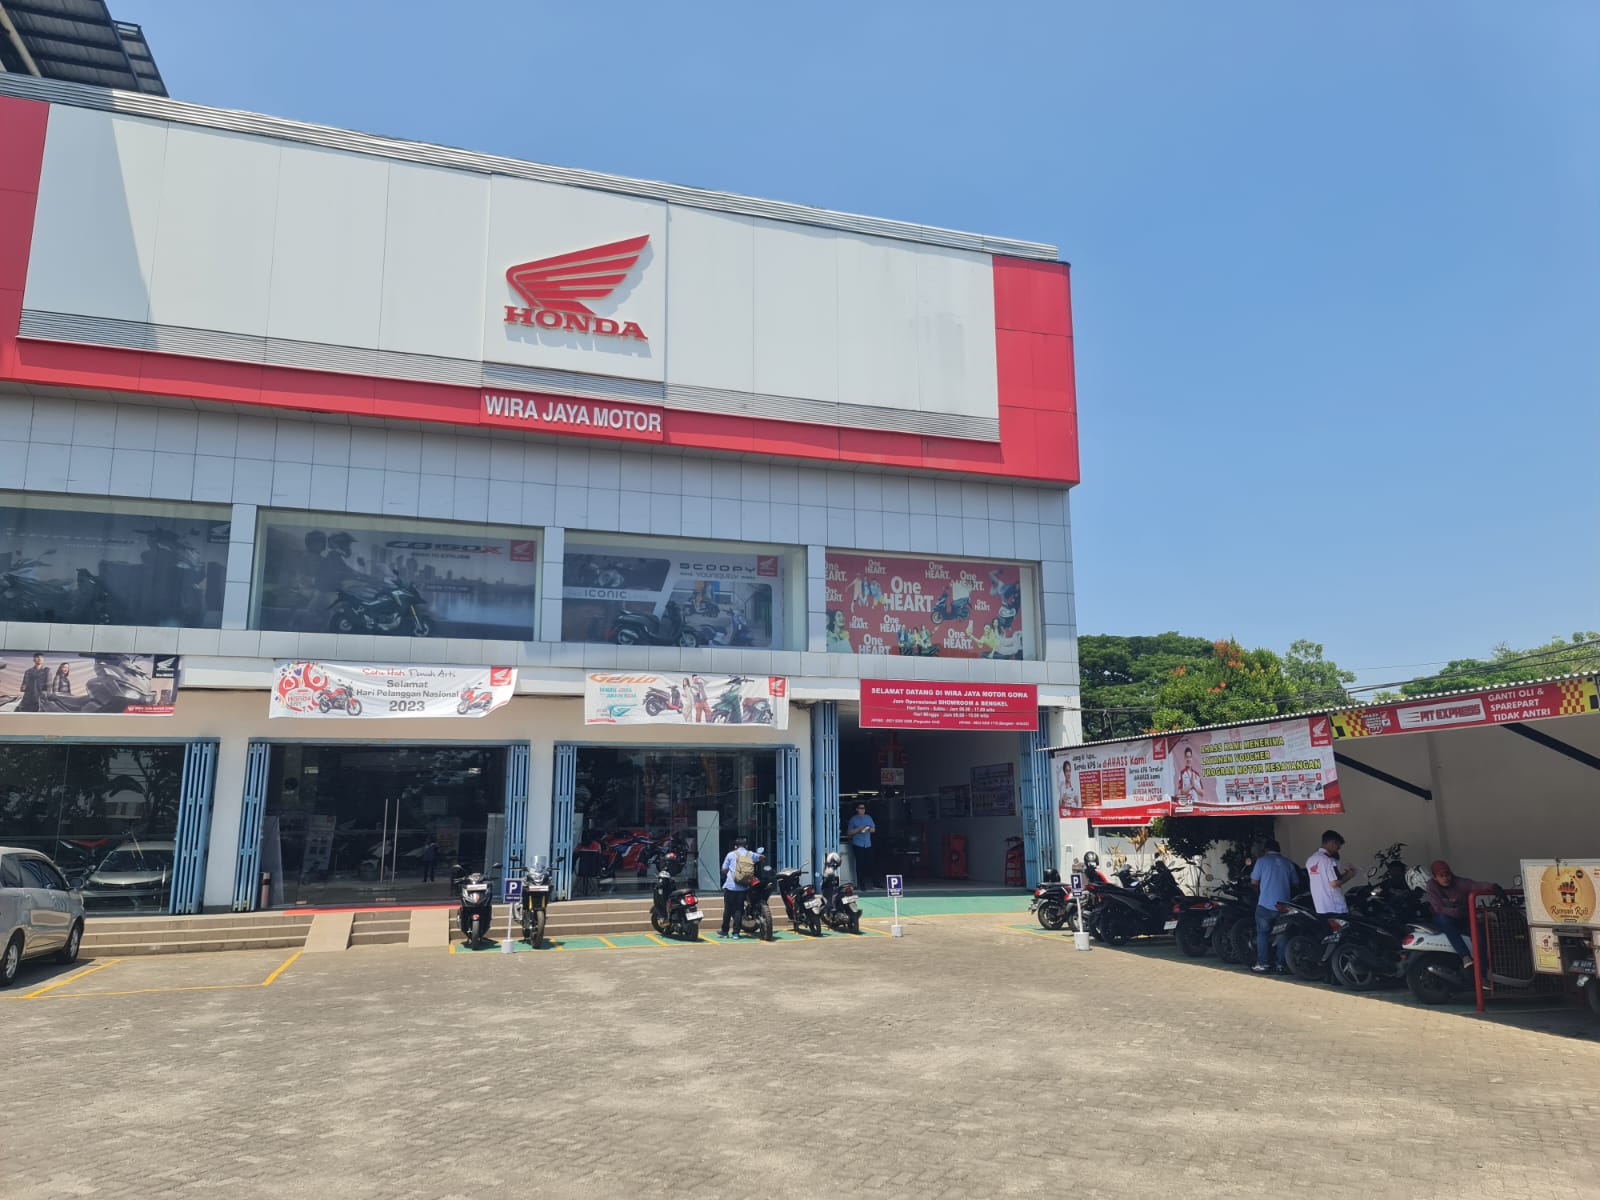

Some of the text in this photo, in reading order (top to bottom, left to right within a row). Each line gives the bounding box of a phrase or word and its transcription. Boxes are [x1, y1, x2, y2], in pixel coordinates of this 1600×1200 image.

[504, 305, 649, 342] HONDA
[485, 395, 661, 432] WIRA JAYA MOTOR
[679, 562, 756, 573] SCOOPY
[929, 562, 943, 571] One
[960, 570, 976, 580] One
[891, 576, 921, 594] One
[584, 589, 627, 599] ICONIC
[884, 615, 900, 624] One
[948, 628, 966, 639] One
[864, 634, 884, 646] One
[386, 680, 428, 689] Selamat
[356, 688, 459, 699] Hari Pelanggan Nasional
[906, 688, 934, 696] DATANG
[964, 690, 981, 698] JAYA
[1488, 688, 1544, 702] GANTI OLI &
[389, 700, 425, 712] 2023
[1490, 698, 1539, 712] SPAREPART
[1420, 705, 1480, 722] PIT EXPRESS
[1493, 708, 1550, 722] TIDAK ANTRI
[1224, 741, 1241, 751] KAMI
[1243, 736, 1284, 750] MENERIMA
[1202, 750, 1270, 766] LAYANAN VOUCHER
[1202, 759, 1321, 777] PROGRAM MOTOR KESAYANGAN
[510, 882, 518, 894] P
[891, 878, 898, 888] P
[1072, 876, 1078, 888] P
